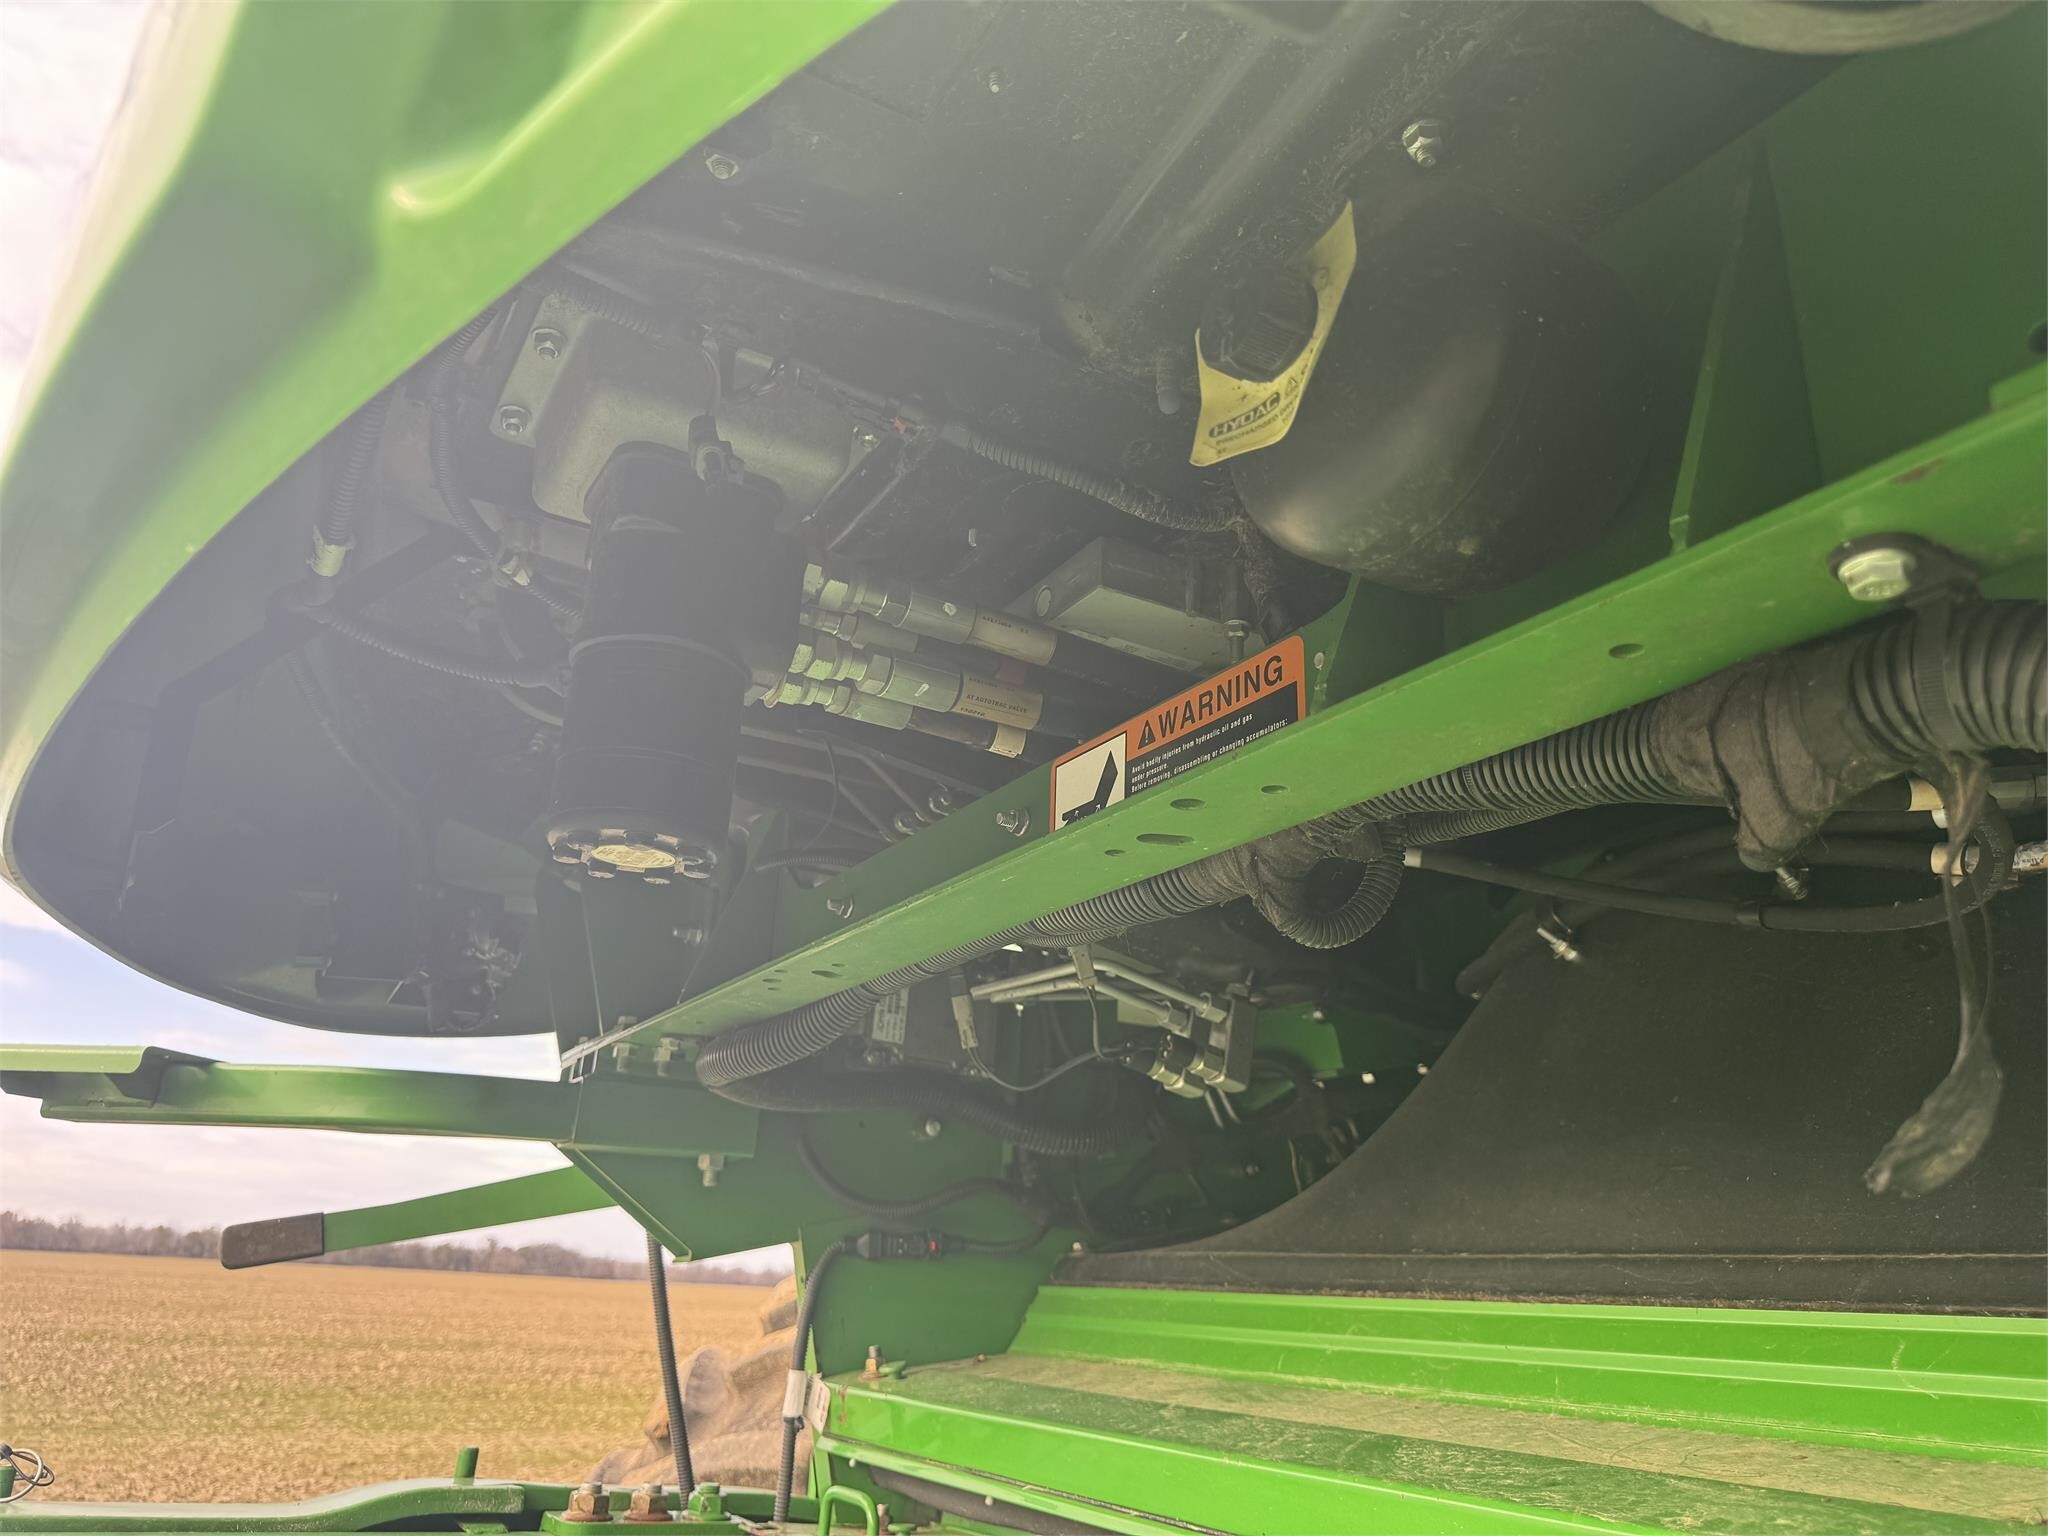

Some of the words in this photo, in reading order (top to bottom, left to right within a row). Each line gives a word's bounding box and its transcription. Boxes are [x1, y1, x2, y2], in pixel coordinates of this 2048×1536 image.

[1213, 393, 1278, 437] HYDAC
[1158, 655, 1283, 738] WARNING
[1131, 781, 1147, 793] Before
[1173, 753, 1211, 775] disassembling
[1212, 750, 1218, 758] or
[1219, 738, 1245, 754] changing
[1246, 718, 1288, 742] accumulators:
[1132, 762, 1145, 773] Avoid
[1146, 756, 1161, 768] bodily
[1162, 746, 1182, 760] injuries
[1182, 740, 1195, 751] from
[1196, 728, 1220, 745] hydraulic
[1221, 724, 1229, 733] oil
[1230, 718, 1240, 729] and
[1242, 713, 1253, 724] gas
[1132, 773, 1145, 783] under
